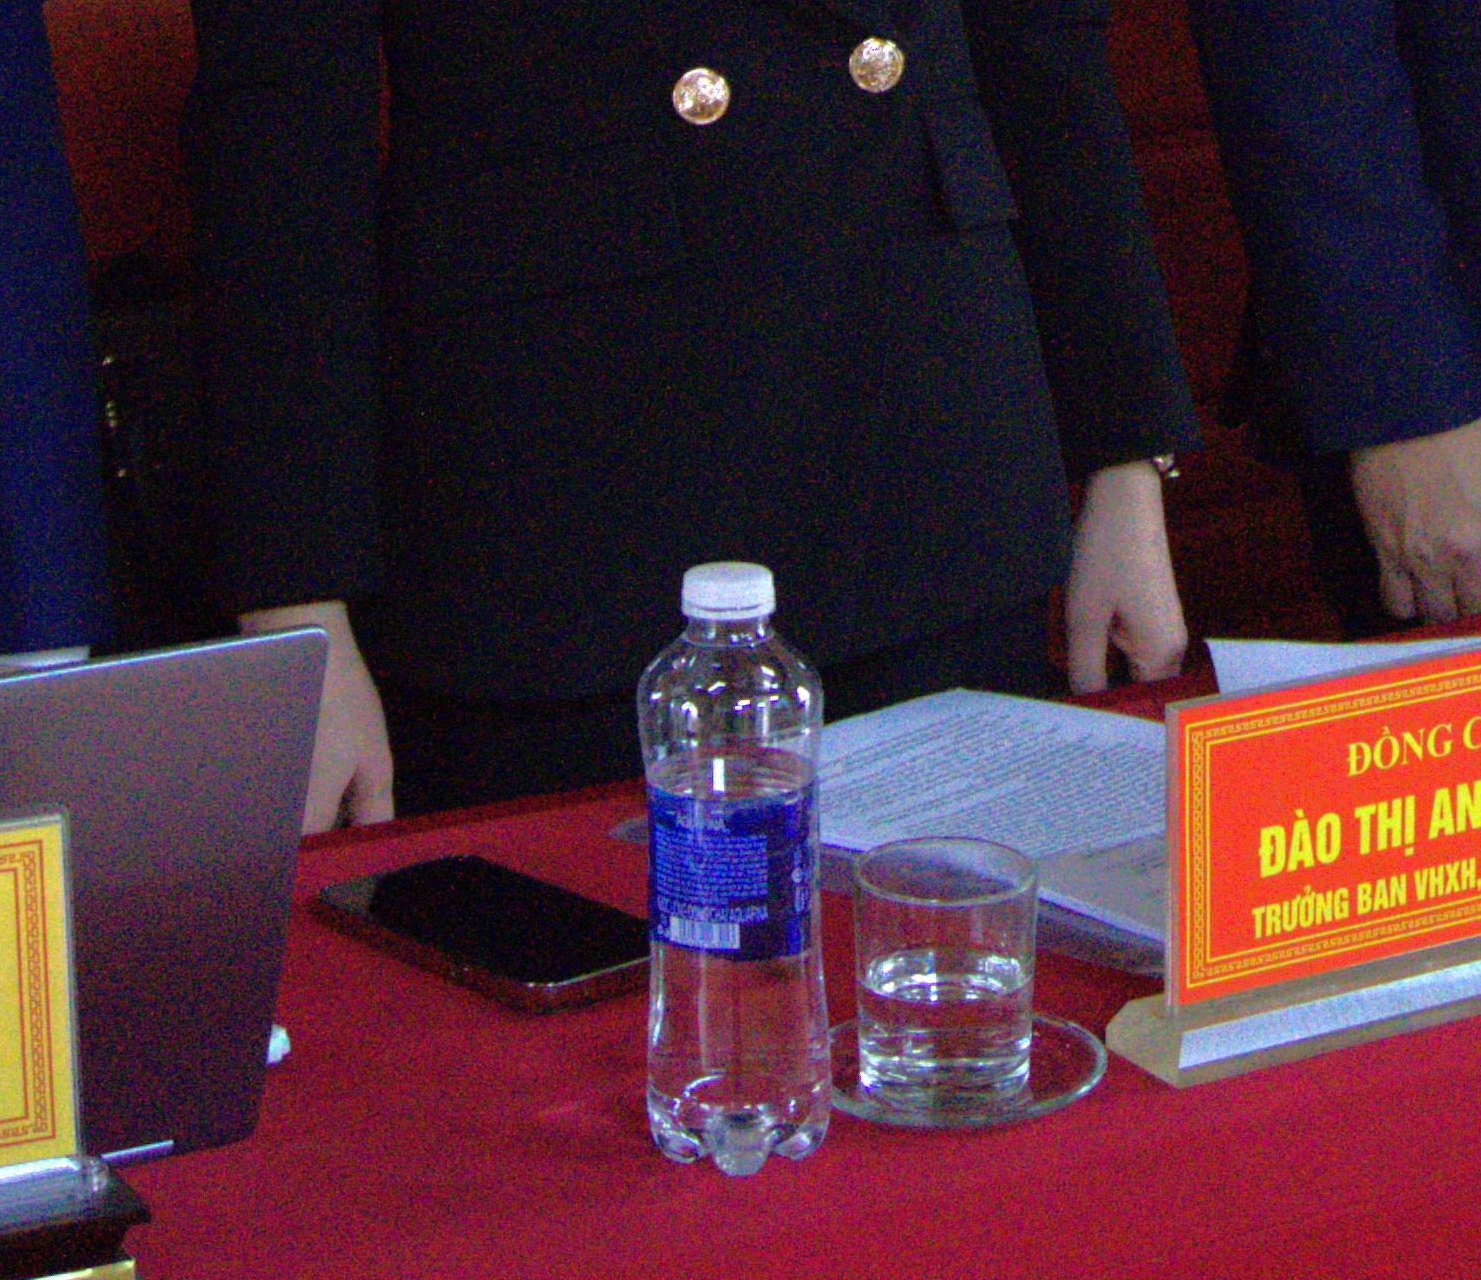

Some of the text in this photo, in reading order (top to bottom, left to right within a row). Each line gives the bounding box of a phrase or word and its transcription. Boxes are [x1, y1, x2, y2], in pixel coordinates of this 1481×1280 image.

[1346, 726, 1453, 777] ĐỒNG
[1258, 809, 1342, 877] ĐÀO
[1354, 795, 1416, 857] THỊ
[1252, 882, 1350, 938] TRƯỞNG
[1356, 873, 1408, 916] BAN
